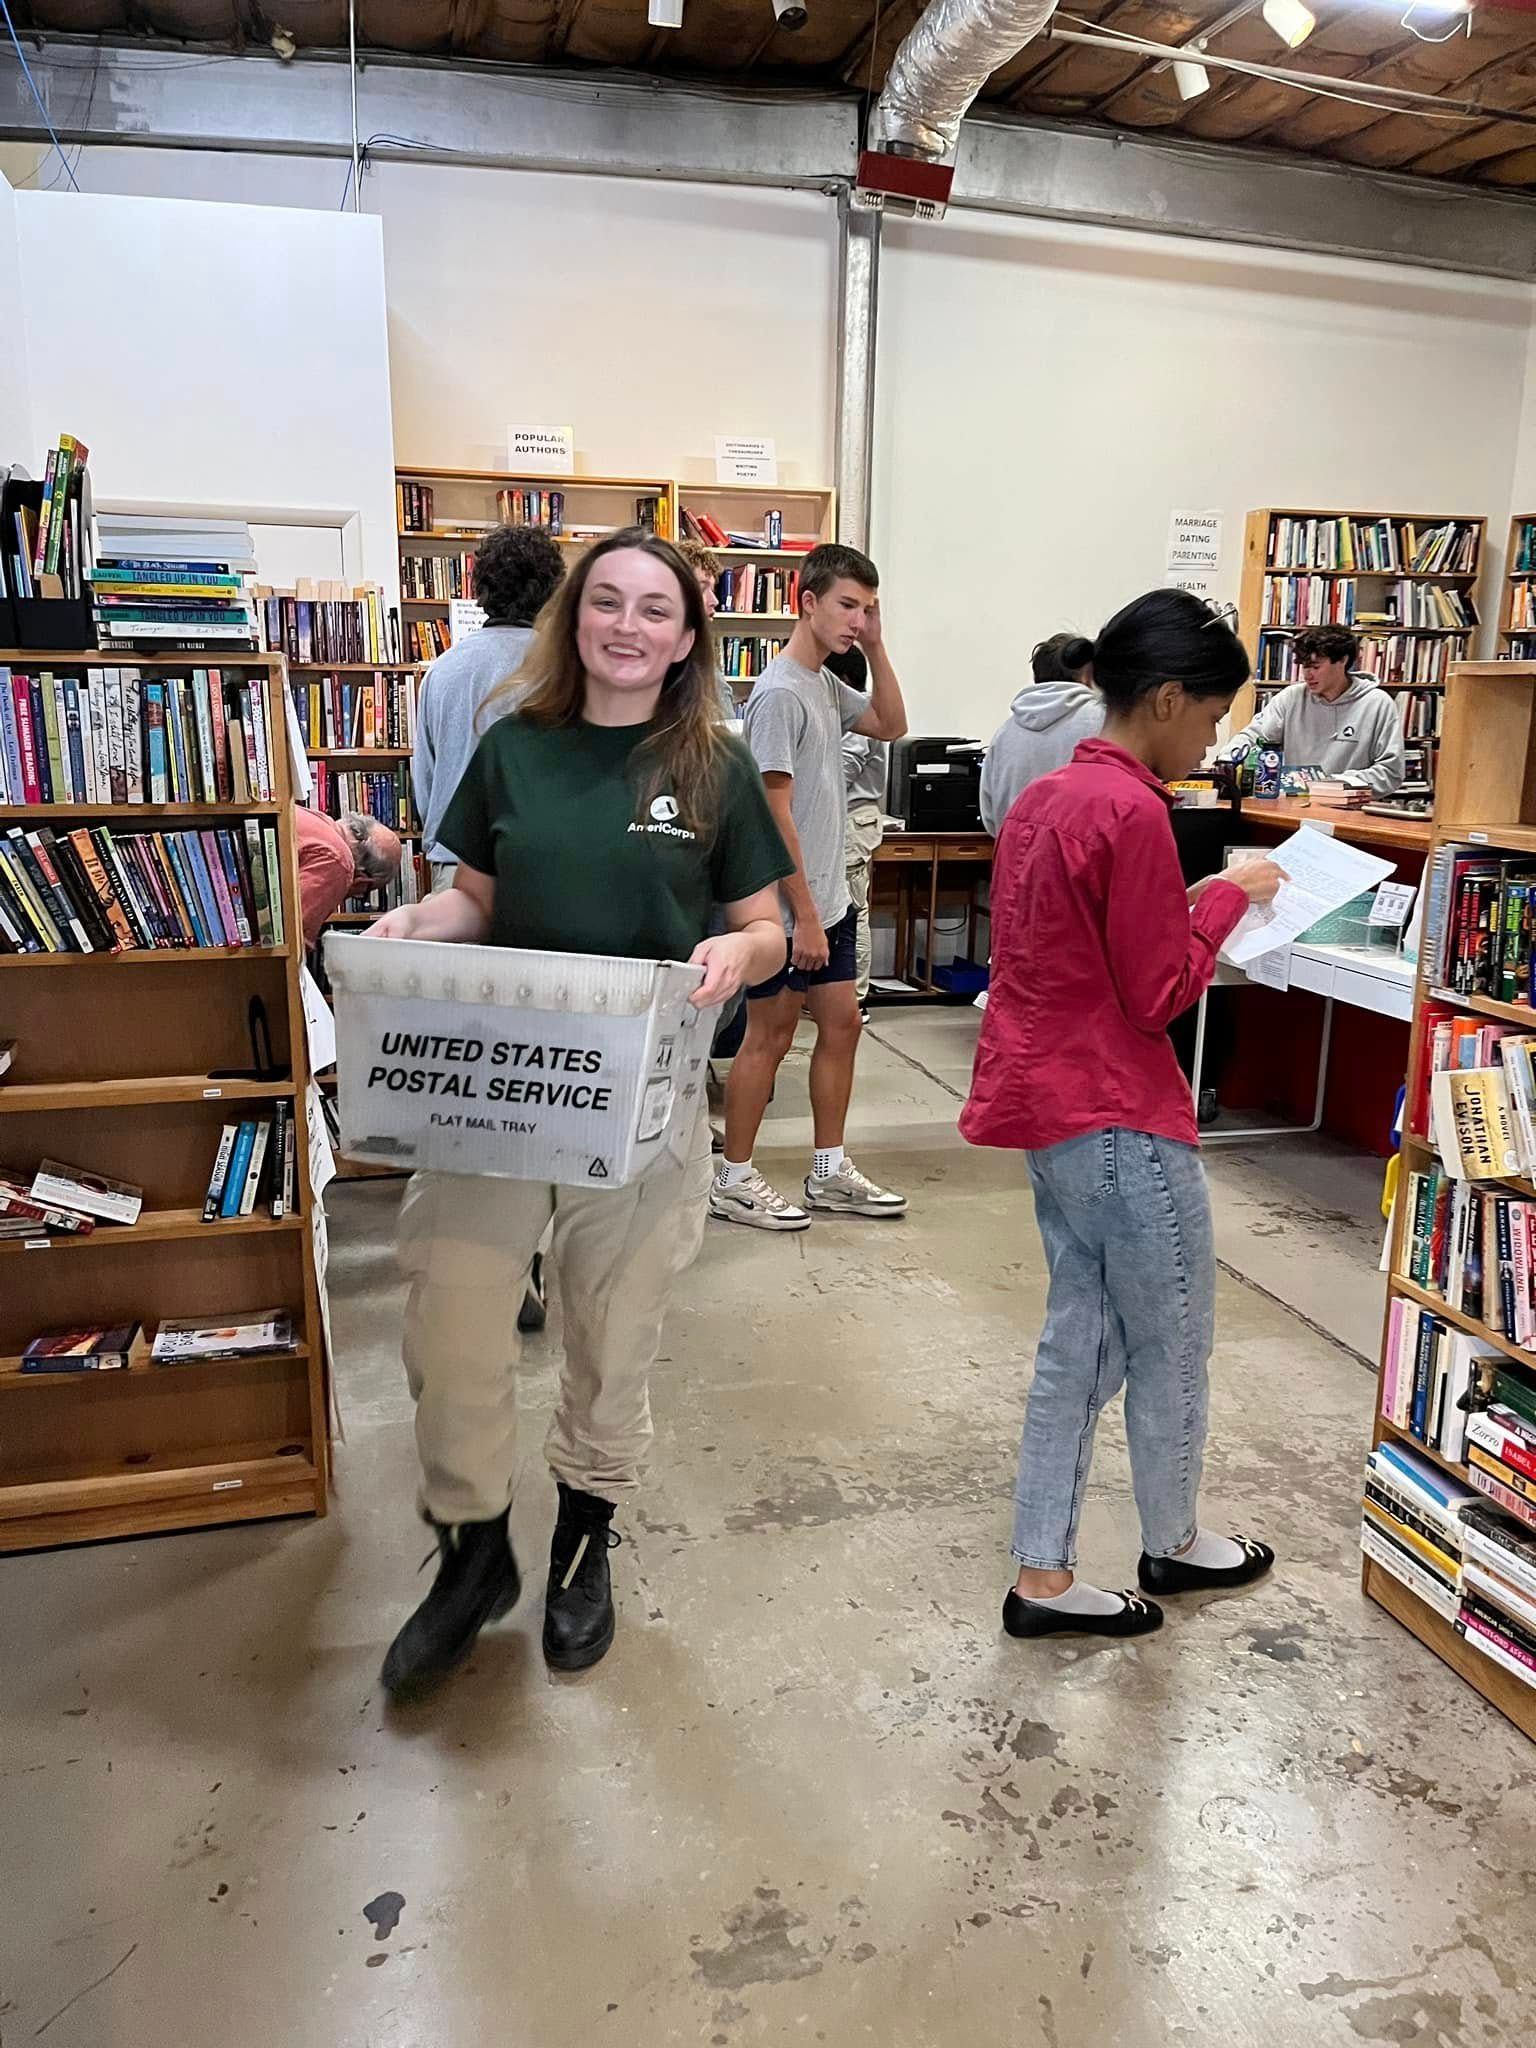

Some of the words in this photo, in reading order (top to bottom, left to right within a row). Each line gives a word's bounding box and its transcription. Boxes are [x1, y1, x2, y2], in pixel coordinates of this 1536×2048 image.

[515, 434, 564, 443] POPULAR
[515, 446, 566, 455] AUTHORS
[1174, 518, 1218, 528] MARRIAGE
[1180, 534, 1210, 543] DATING
[1172, 551, 1217, 560] PARENTING
[132, 574, 172, 584] TANGLED
[174, 574, 186, 584] UP
[189, 575, 199, 584] IN
[200, 576, 219, 585] YOU
[1177, 582, 1207, 590] HEALTH
[18, 698, 28, 717] FREE
[22, 718, 32, 751] SUMMER
[25, 752, 36, 786] READING
[627, 823, 695, 840] AmeriCorps
[110, 871, 134, 920] MILKWEED
[381, 1032, 484, 1063] UNITED
[490, 1041, 602, 1074] STATES
[368, 1066, 477, 1099] POSTAL
[486, 1077, 612, 1110] SERVICE
[430, 1113, 464, 1128] FLAT
[466, 1116, 497, 1131] MAIL
[501, 1119, 538, 1135] TRAY
[1456, 1102, 1475, 1155] EVISON
[1464, 1084, 1492, 1164] JONATHAN
[1500, 1114, 1510, 1140] NOVEL
[1512, 1228, 1524, 1296] WIDOWLAND
[1471, 1422, 1500, 1448] Zorro
[1504, 1446, 1532, 1470] ISABEL
[1490, 1530, 1513, 1549] Little
[1478, 1622, 1508, 1649] MITFORD
[1509, 1644, 1534, 1667] AFFAIR
